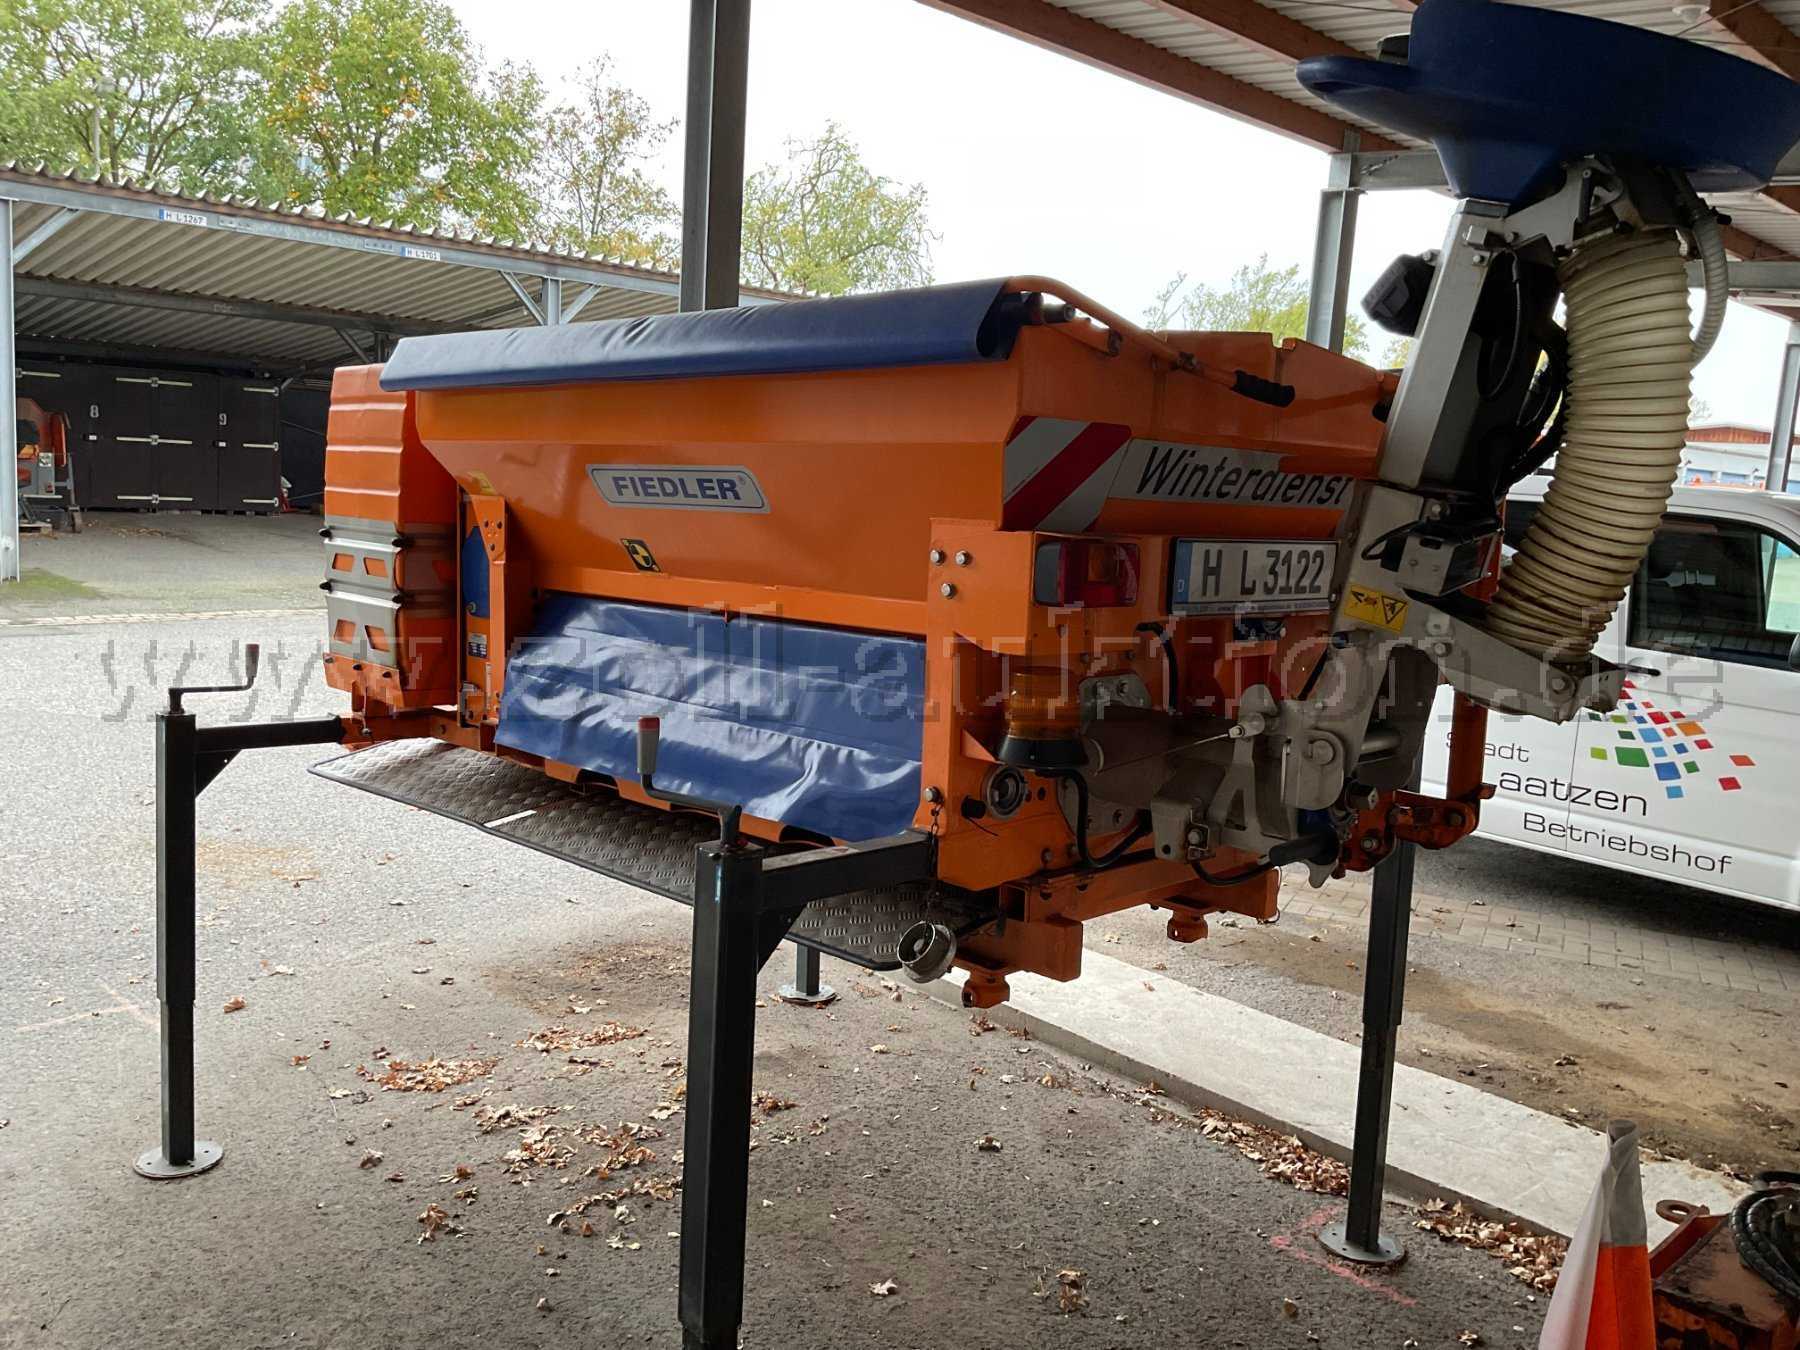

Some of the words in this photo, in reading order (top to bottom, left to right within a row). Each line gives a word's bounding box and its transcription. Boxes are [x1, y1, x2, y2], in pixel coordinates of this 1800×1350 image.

[90, 404, 100, 418] 8
[219, 413, 228, 425] 9
[612, 476, 741, 500] FIEDLER
[1202, 549, 1223, 597] H
[1499, 771, 1648, 817] aatzen
[1523, 811, 1733, 874] Betriebshof
